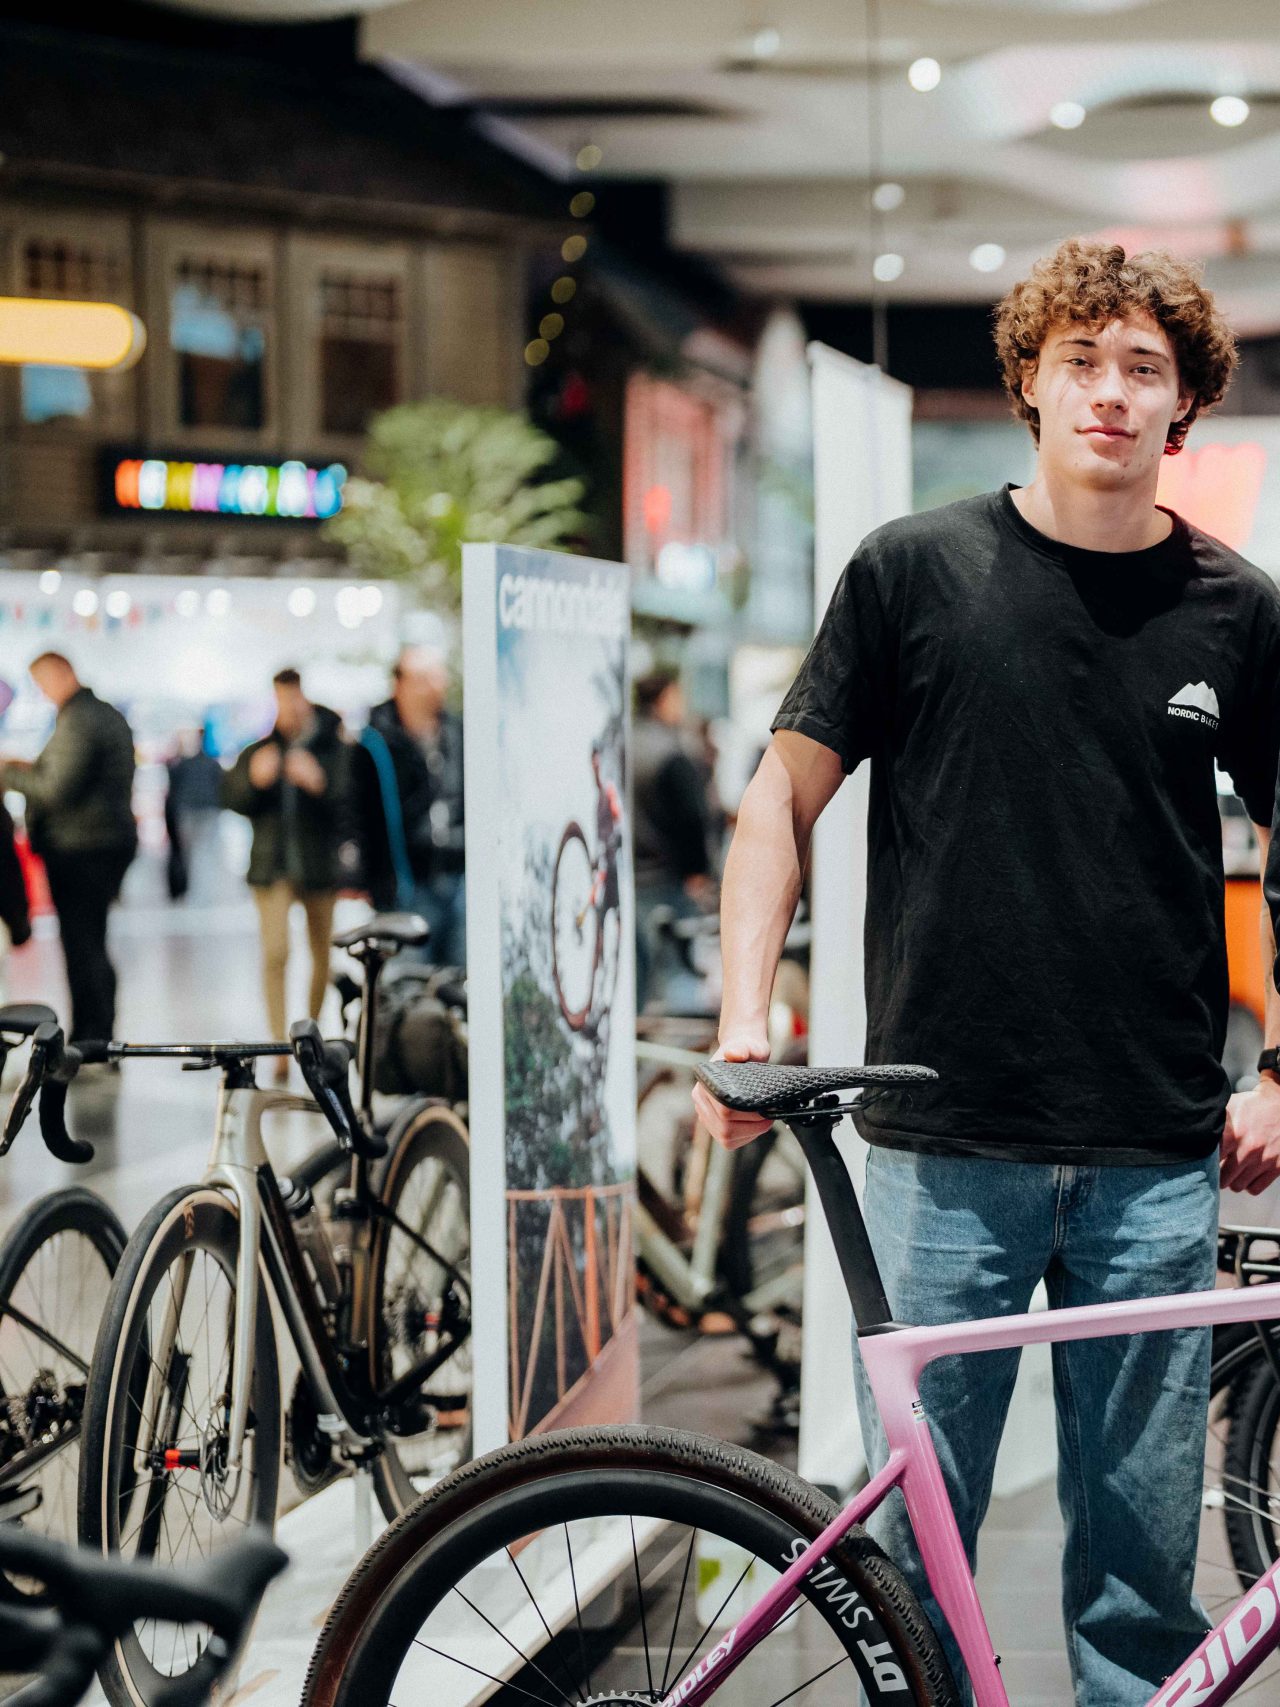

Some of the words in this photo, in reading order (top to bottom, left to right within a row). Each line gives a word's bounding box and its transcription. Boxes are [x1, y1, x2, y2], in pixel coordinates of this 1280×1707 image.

[1167, 706, 1199, 721] NORDIC
[780, 1537, 875, 1629] SWIS
[857, 1638, 909, 1692] DT
